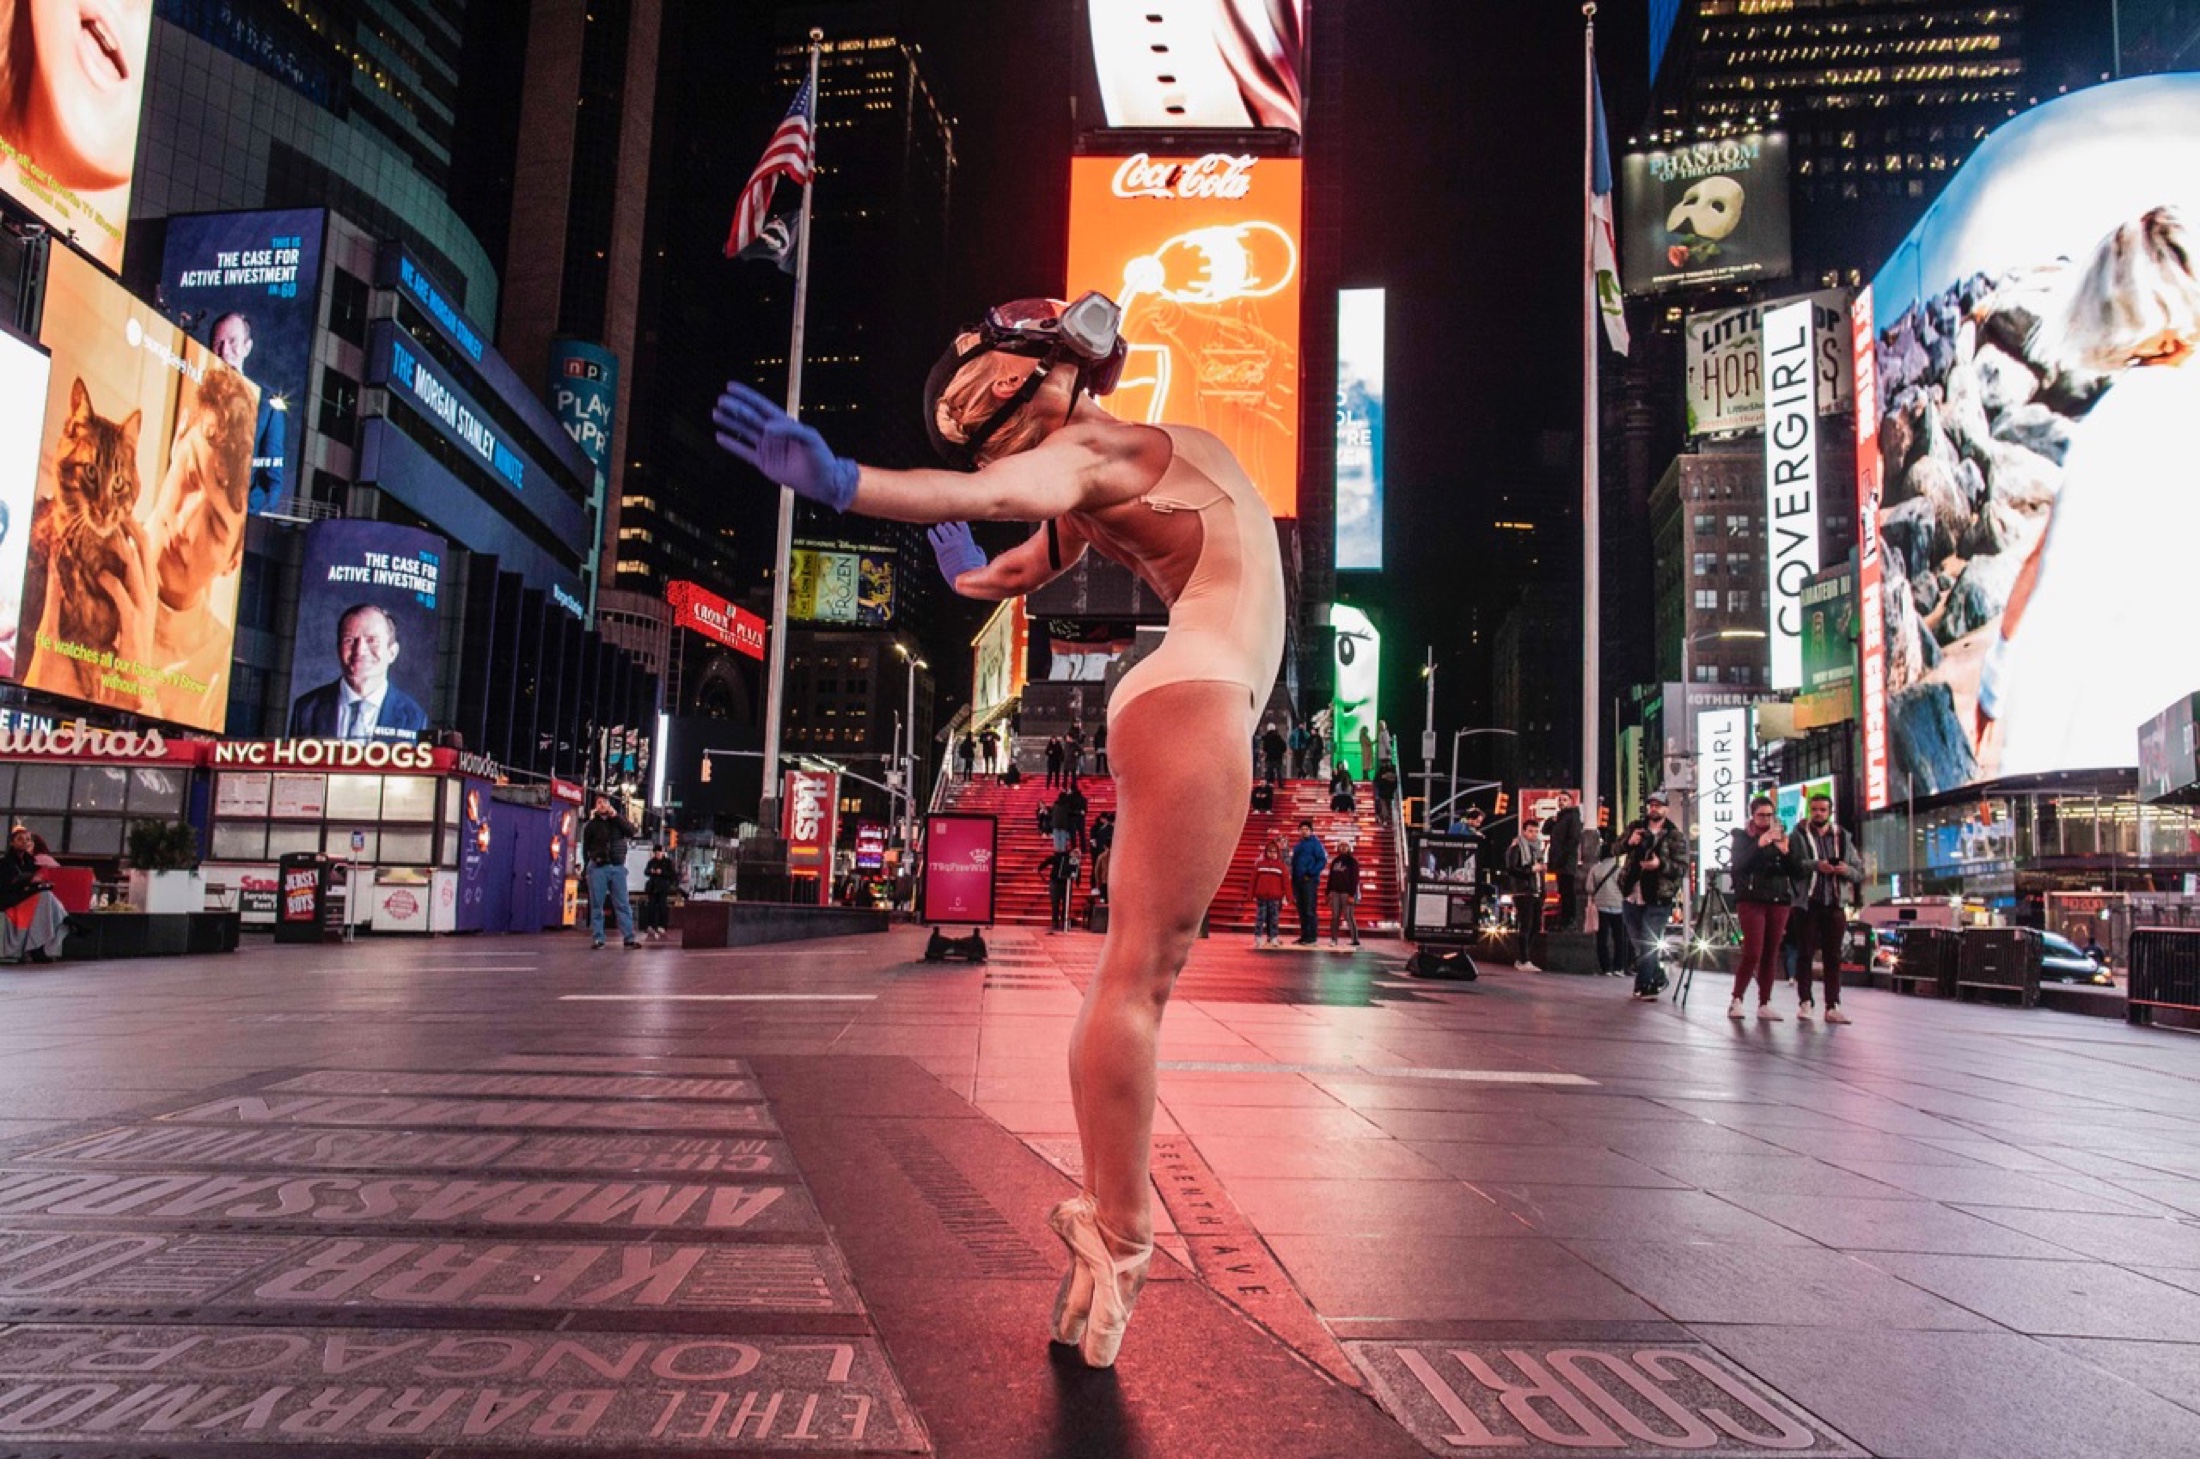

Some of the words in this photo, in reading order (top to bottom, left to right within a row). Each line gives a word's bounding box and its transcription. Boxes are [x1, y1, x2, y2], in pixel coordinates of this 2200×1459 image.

[1649, 144, 1760, 175] PHANTOM
[180, 270, 222, 288] ACTIVE
[224, 265, 298, 285] INVESTMENT
[217, 251, 240, 268] THE
[241, 250, 273, 267] CASE
[274, 248, 300, 265] FOR
[1703, 306, 1776, 353] LITTL
[393, 341, 416, 390] THE
[414, 363, 458, 429] MORGAN
[456, 405, 496, 463] STANLEY
[1771, 326, 1812, 638] COVERGIRL
[327, 565, 371, 583] ACTIVE
[372, 569, 437, 596] INVESTMENT
[364, 551, 390, 569] THE
[391, 556, 421, 575] CASE
[421, 563, 438, 580] FOR
[831, 556, 853, 618] FROZEN
[55, 640, 99, 665] watches
[101, 672, 139, 695] without
[214, 741, 266, 764] NYC
[273, 738, 434, 768] HOTDOGS
[1713, 721, 1733, 870] OVERGIRL
[286, 871, 319, 891] JERSEY
[286, 895, 316, 914] BOYS
[1154, 1142, 1224, 1225] SEVENTH
[1211, 1244, 1271, 1295] AVE
[254, 1240, 709, 1306] KERR
[0, 1331, 855, 1384] LONGACRE
[0, 1383, 618, 1437] BARRYMO
[648, 1388, 872, 1440] ETHEL
[1394, 1347, 1816, 1449] CORT
